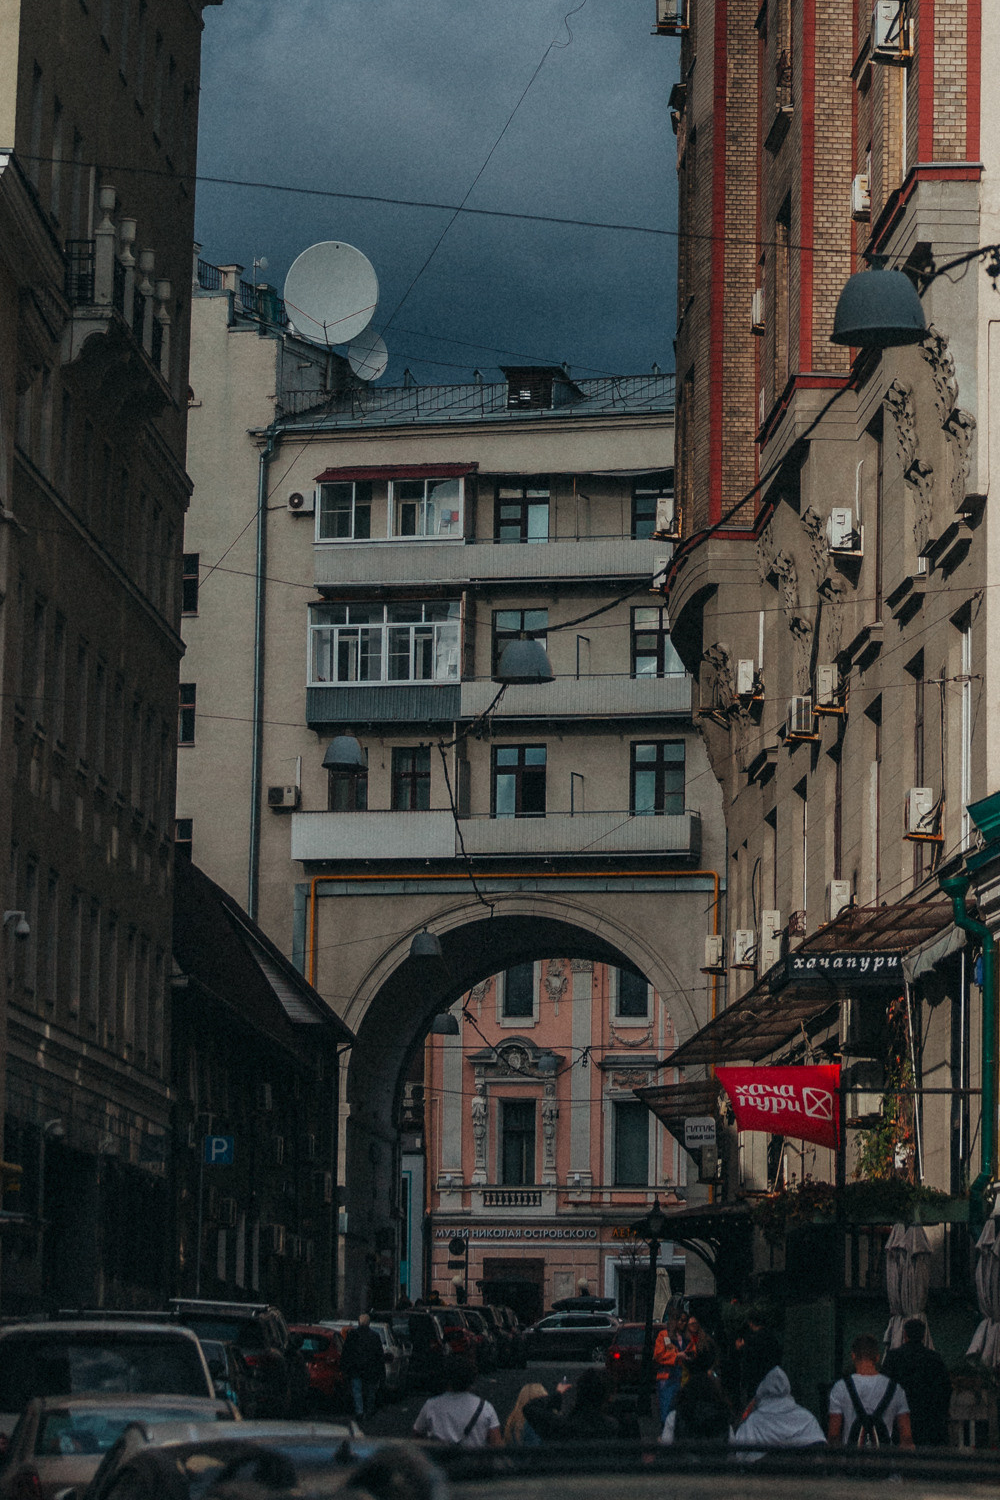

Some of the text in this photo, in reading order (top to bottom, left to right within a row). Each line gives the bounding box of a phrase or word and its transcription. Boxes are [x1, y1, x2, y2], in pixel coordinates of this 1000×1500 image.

[793, 956, 898, 973] хачапури
[735, 1083, 796, 1098] хача
[737, 1095, 802, 1114] пури
[211, 1138, 228, 1161] P
[435, 1227, 597, 1238] МУЗЕЙ НИКОЛАЯ ОСТРОВСКОГО
